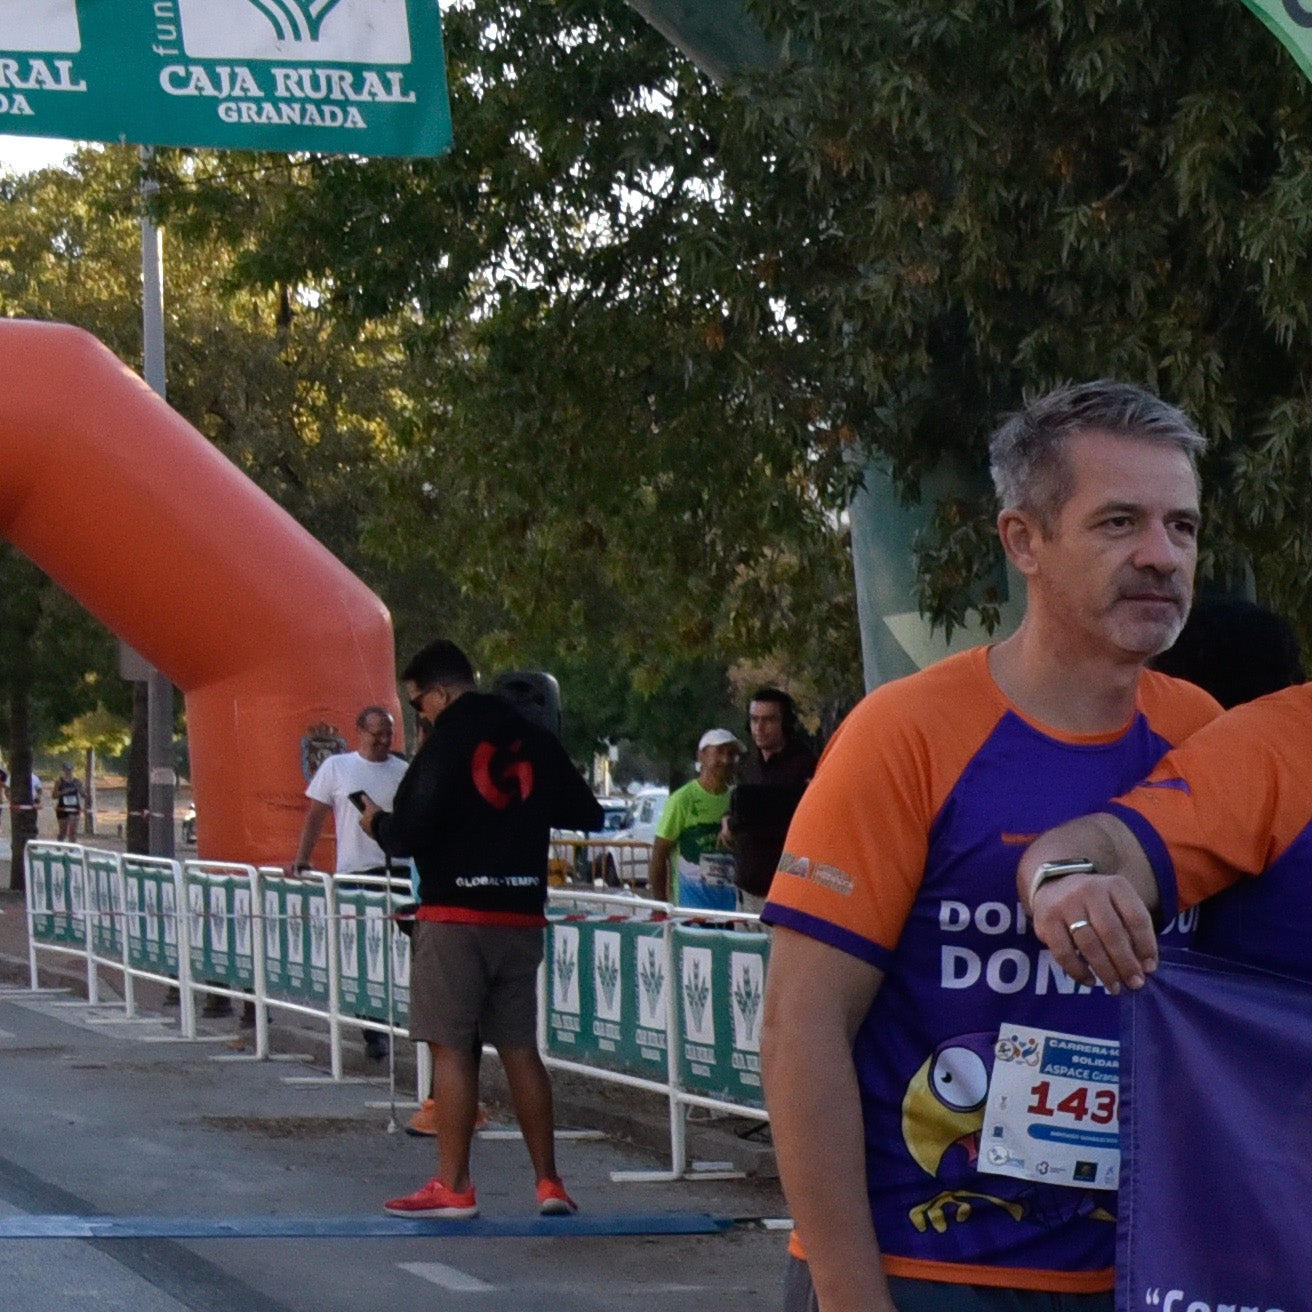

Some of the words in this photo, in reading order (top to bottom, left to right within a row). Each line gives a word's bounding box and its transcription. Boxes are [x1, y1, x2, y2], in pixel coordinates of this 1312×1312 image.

[160, 65, 264, 98] CAJA
[271, 67, 416, 102] RURAL
[218, 101, 367, 128] GRANADA
[1044, 1063, 1090, 1079] ASPACE
[1027, 1081, 1119, 1125] 143
